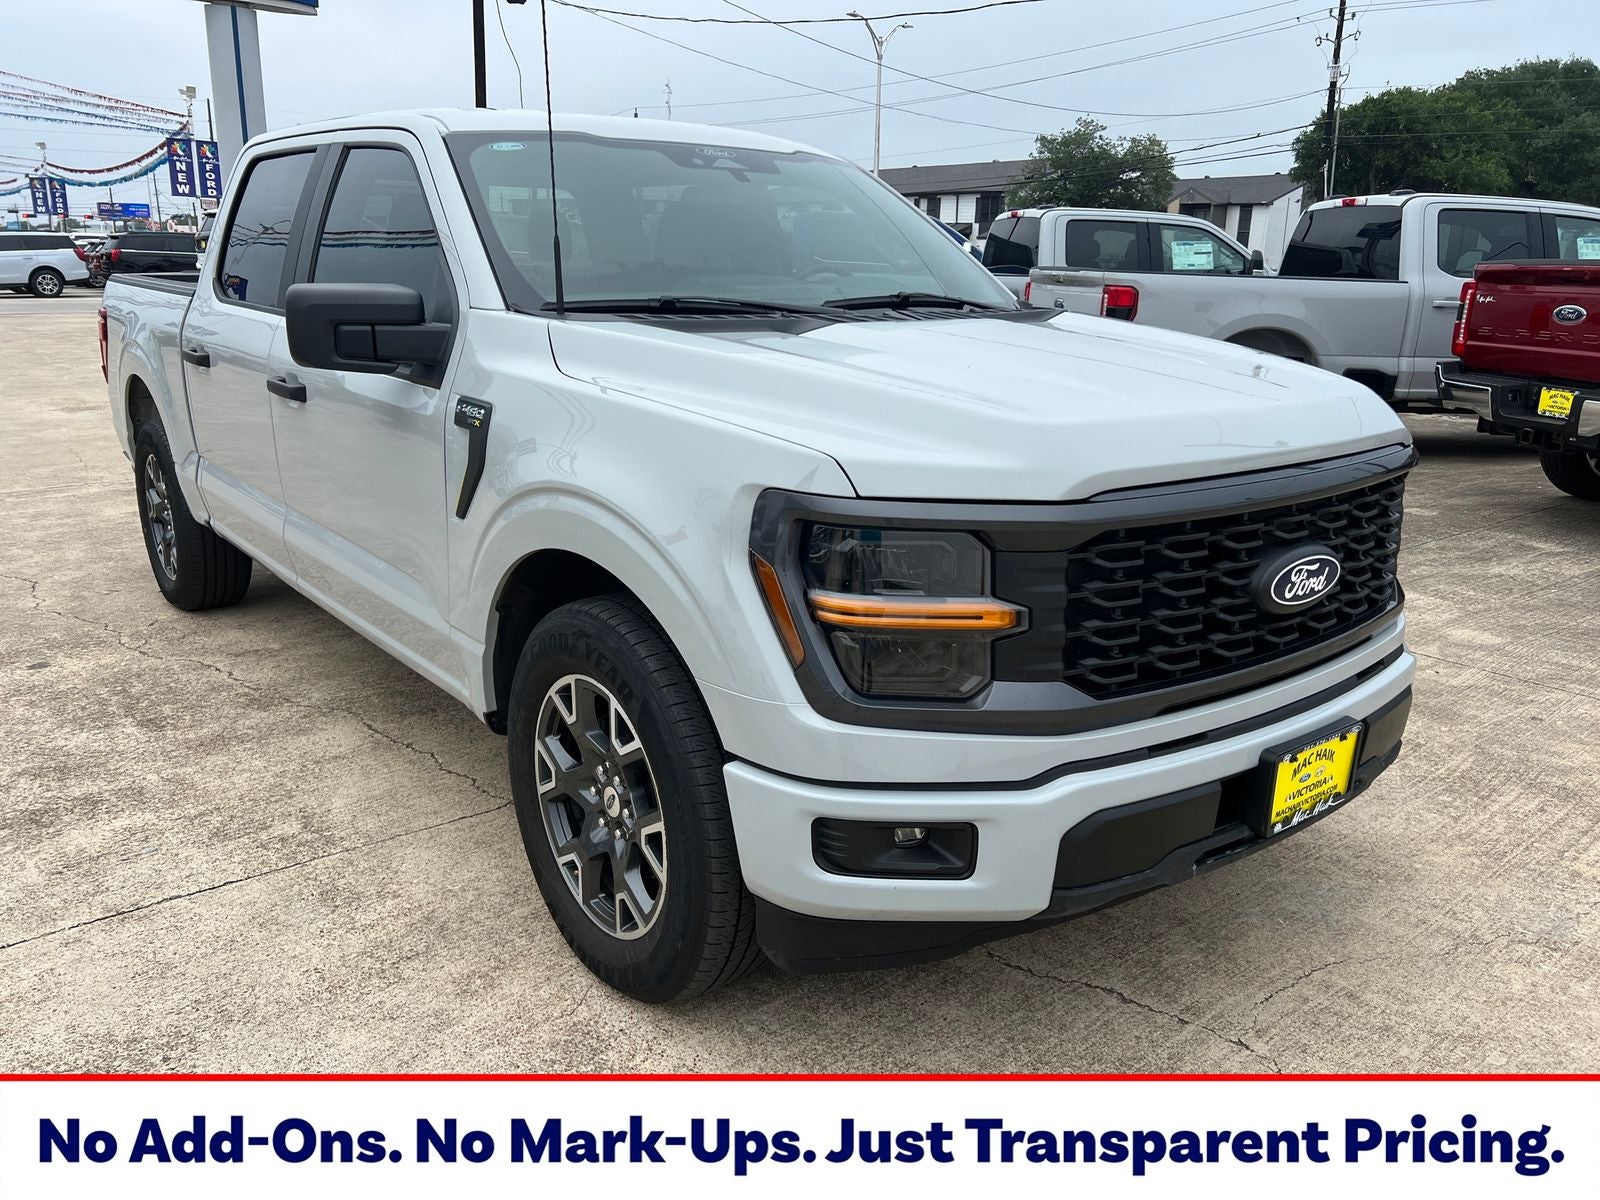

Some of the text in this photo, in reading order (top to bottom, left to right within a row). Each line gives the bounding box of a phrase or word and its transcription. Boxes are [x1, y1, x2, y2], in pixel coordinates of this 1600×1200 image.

[175, 161, 190, 194] NEW
[205, 163, 218, 196] FORD
[35, 191, 46, 213] NEW
[55, 192, 64, 214] FORD
[1477, 326, 1573, 343] SUPER
[1284, 562, 1330, 600] Ford
[1291, 752, 1315, 782] MAC
[1314, 748, 1336, 763] HAIK
[1291, 777, 1328, 800] VICTORIA
